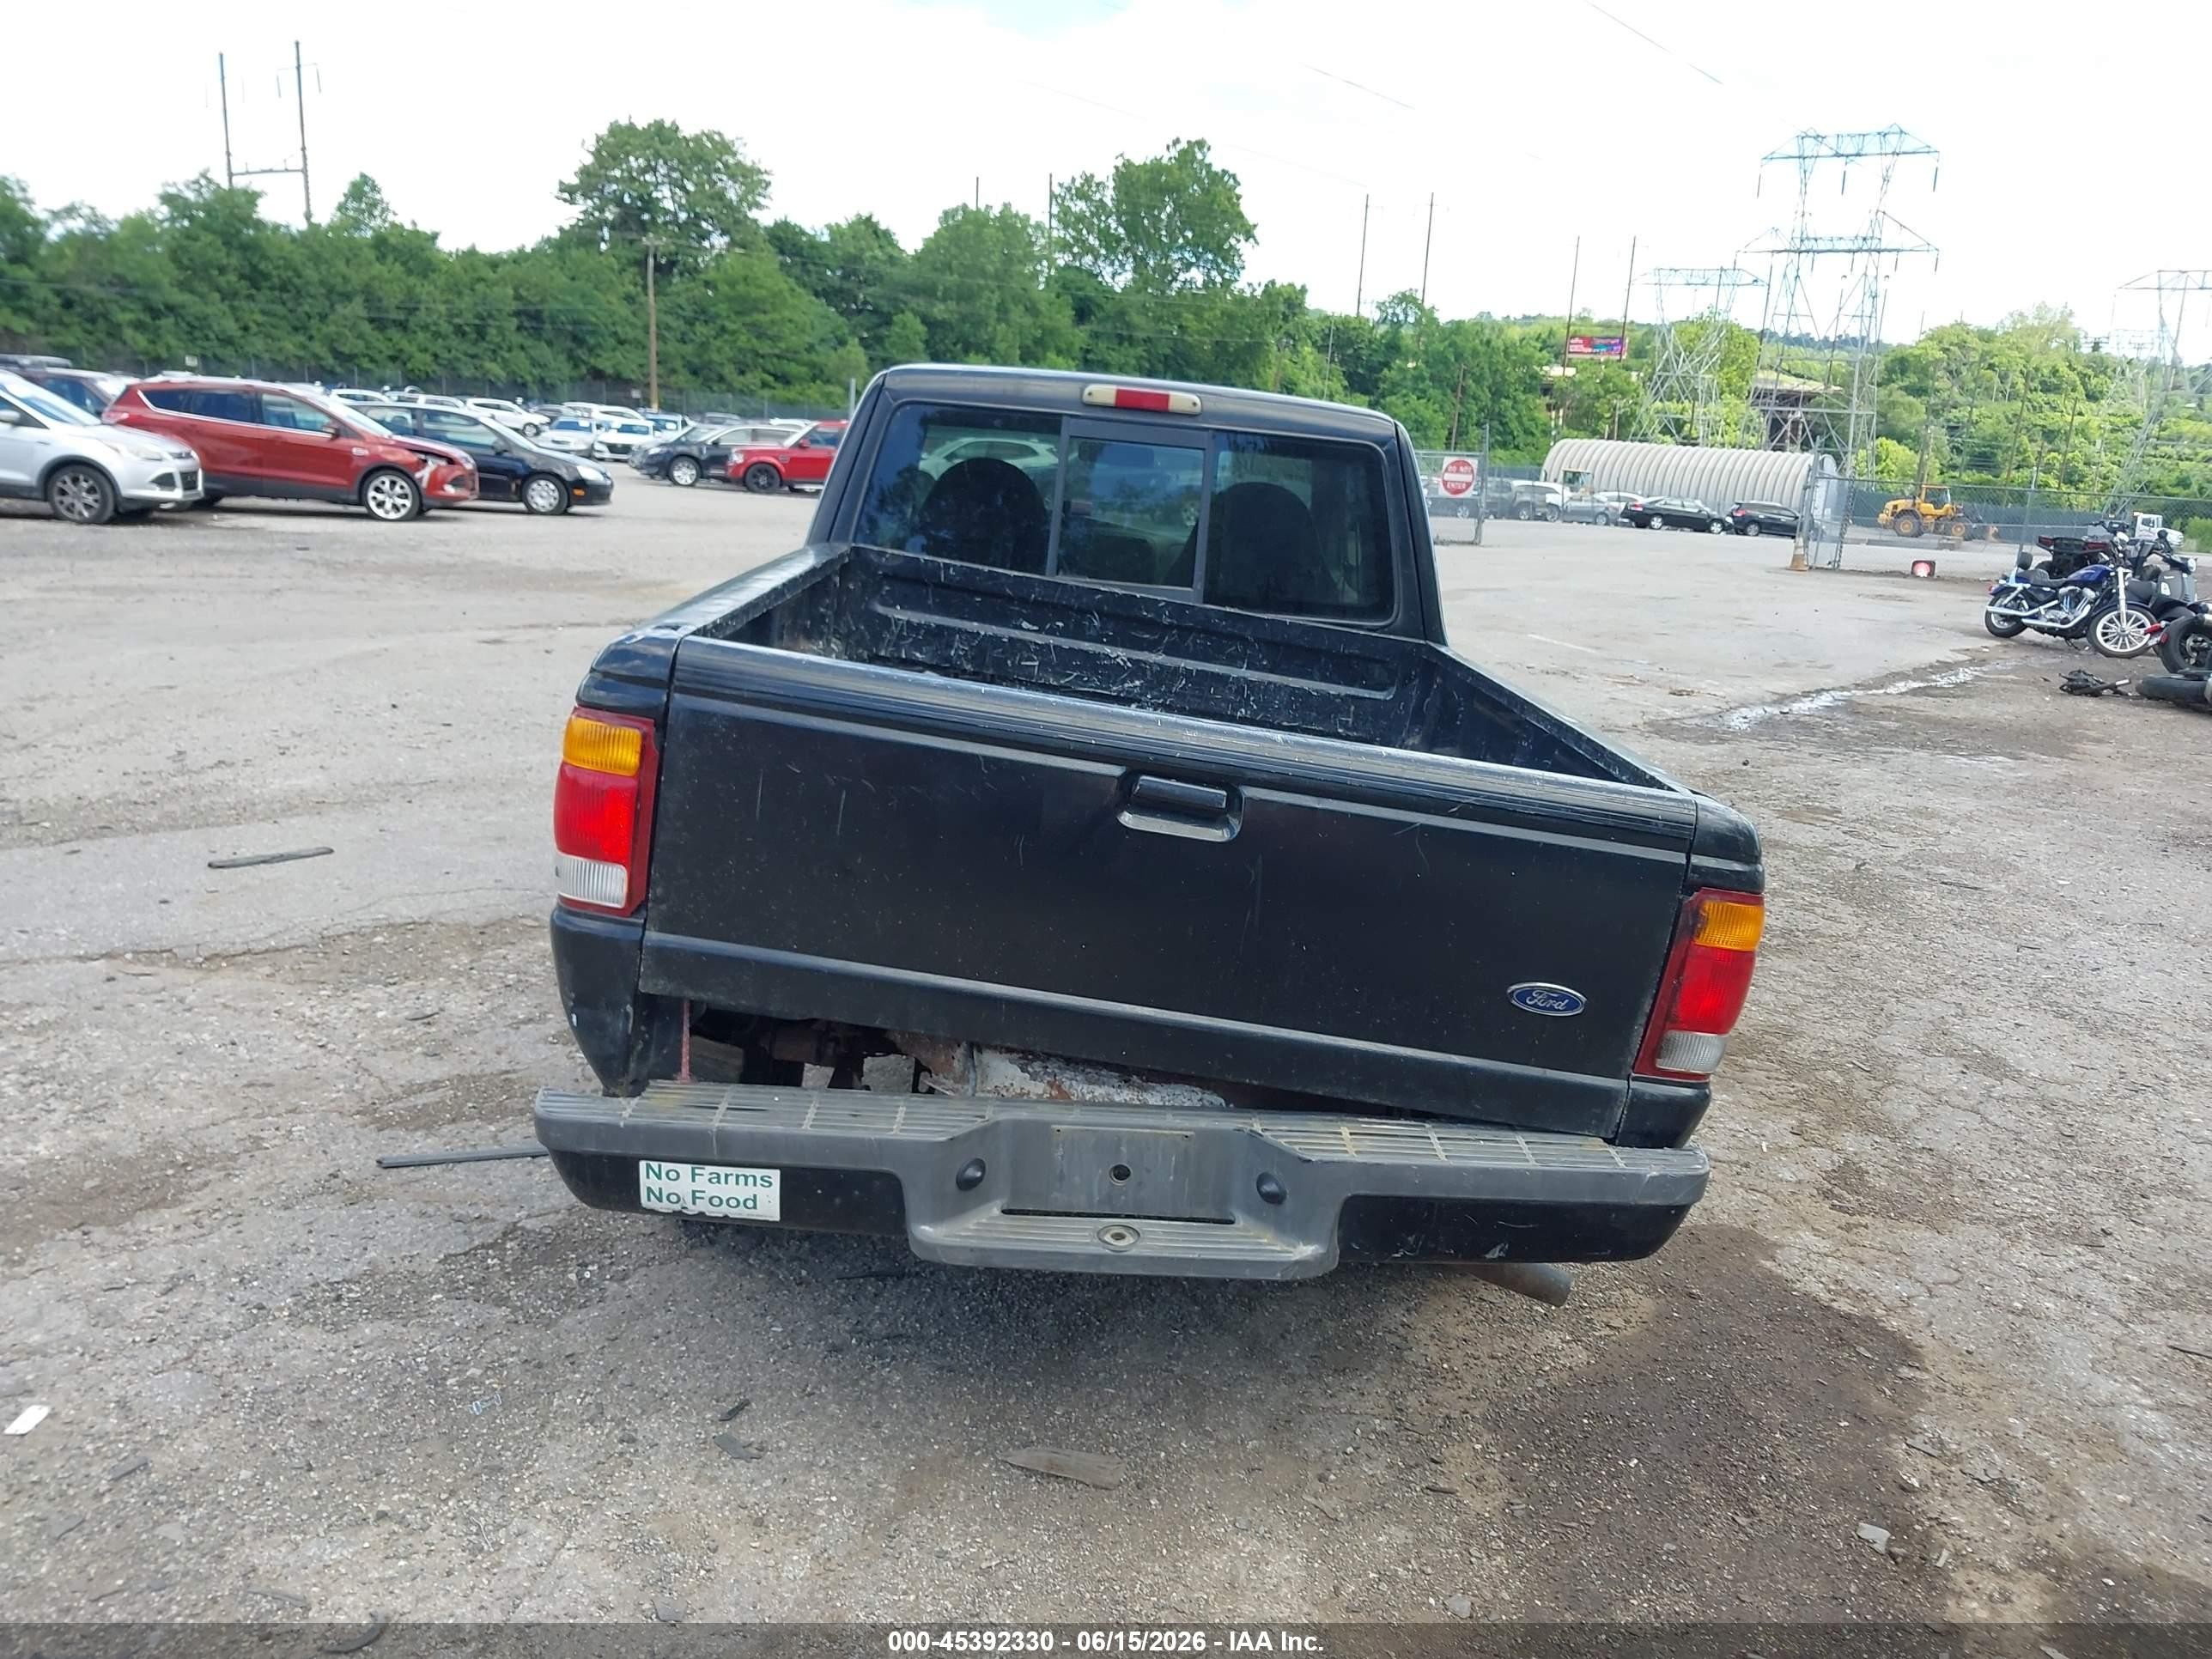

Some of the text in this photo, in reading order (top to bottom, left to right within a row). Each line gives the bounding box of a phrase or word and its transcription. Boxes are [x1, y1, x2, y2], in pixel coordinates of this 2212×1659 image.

[1526, 989, 1569, 1010] Ford
[645, 1162, 773, 1188] No Farms
[647, 1186, 758, 1210] No Food
